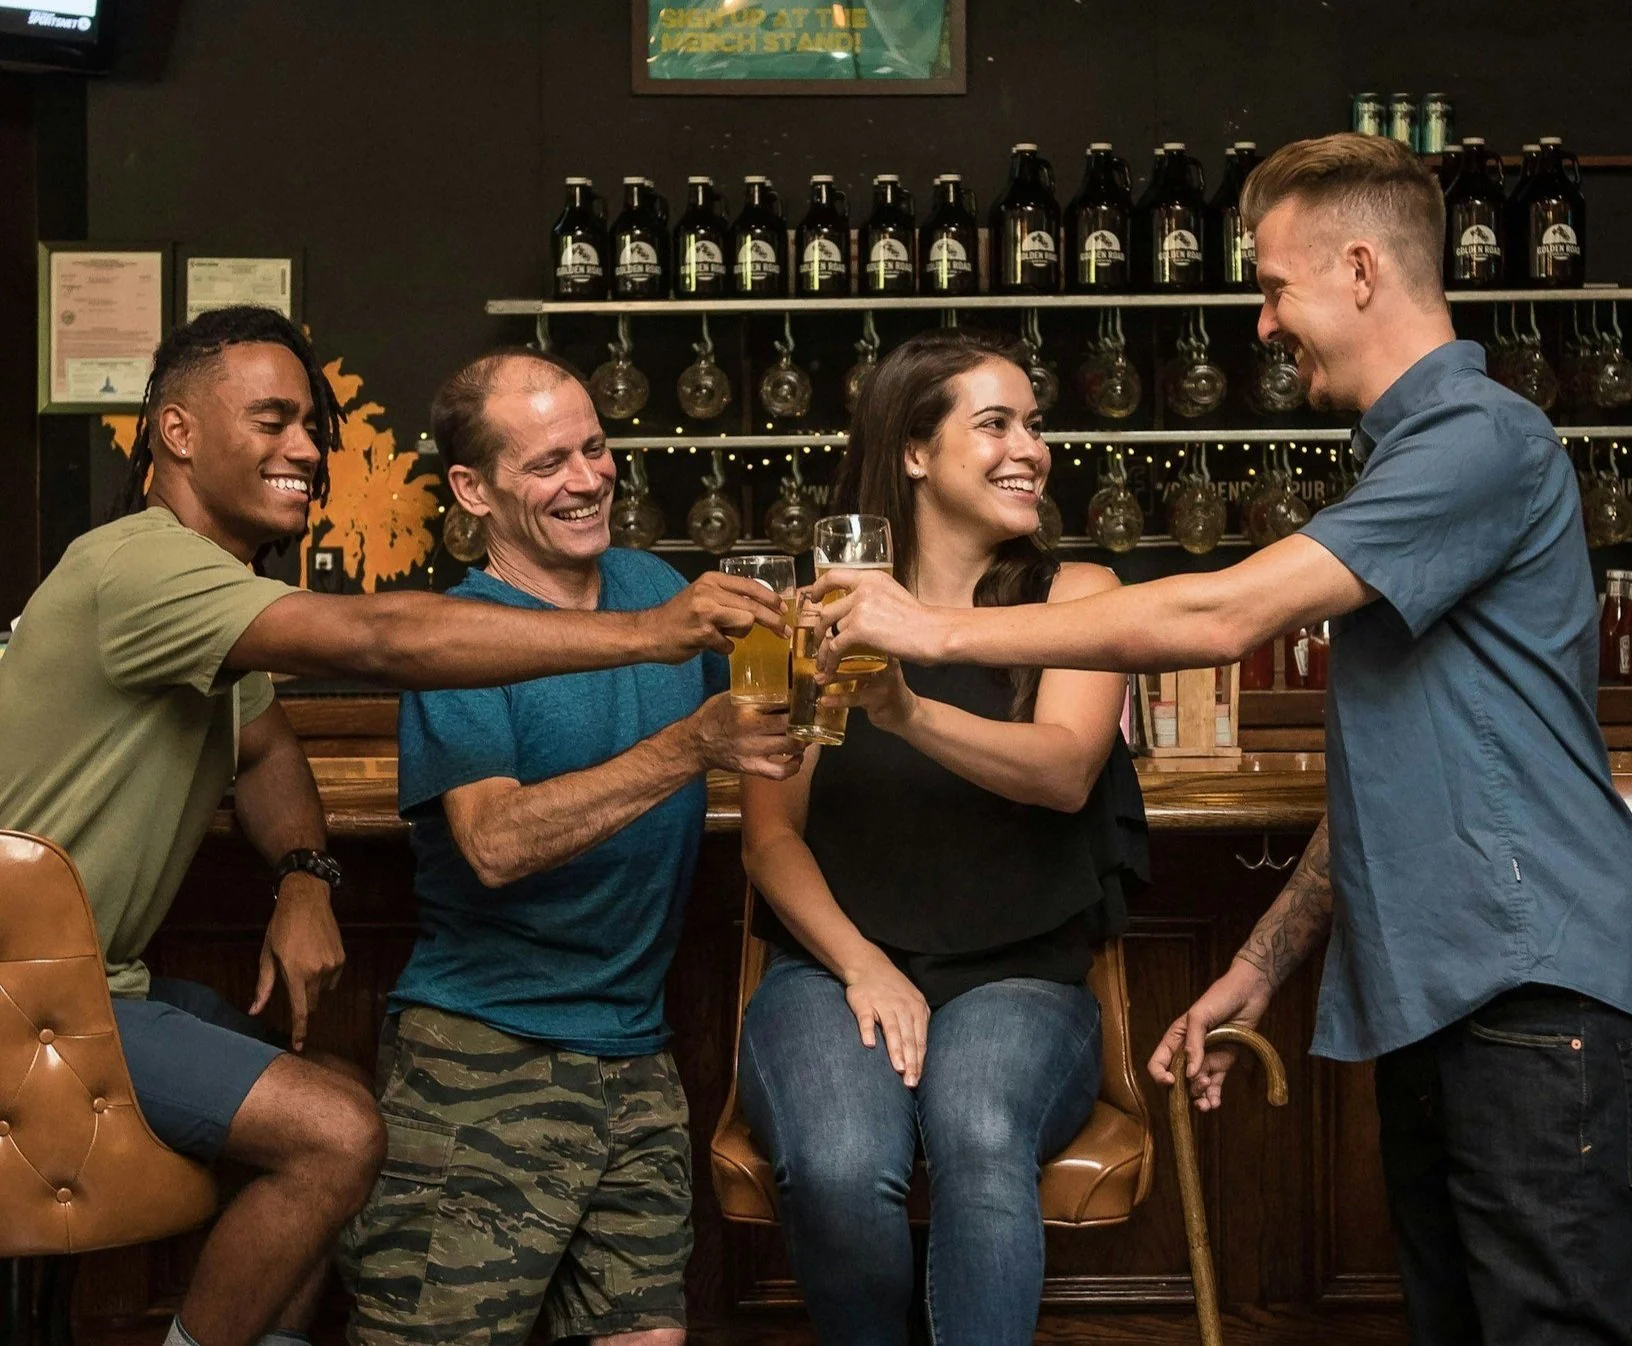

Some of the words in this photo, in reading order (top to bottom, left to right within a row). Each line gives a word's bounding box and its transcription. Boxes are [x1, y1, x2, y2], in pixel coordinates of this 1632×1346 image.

[772, 8, 808, 28] AT
[660, 31, 757, 53] MERCH
[763, 31, 862, 53] STAND!
[1018, 251, 1044, 261] OLDEN
